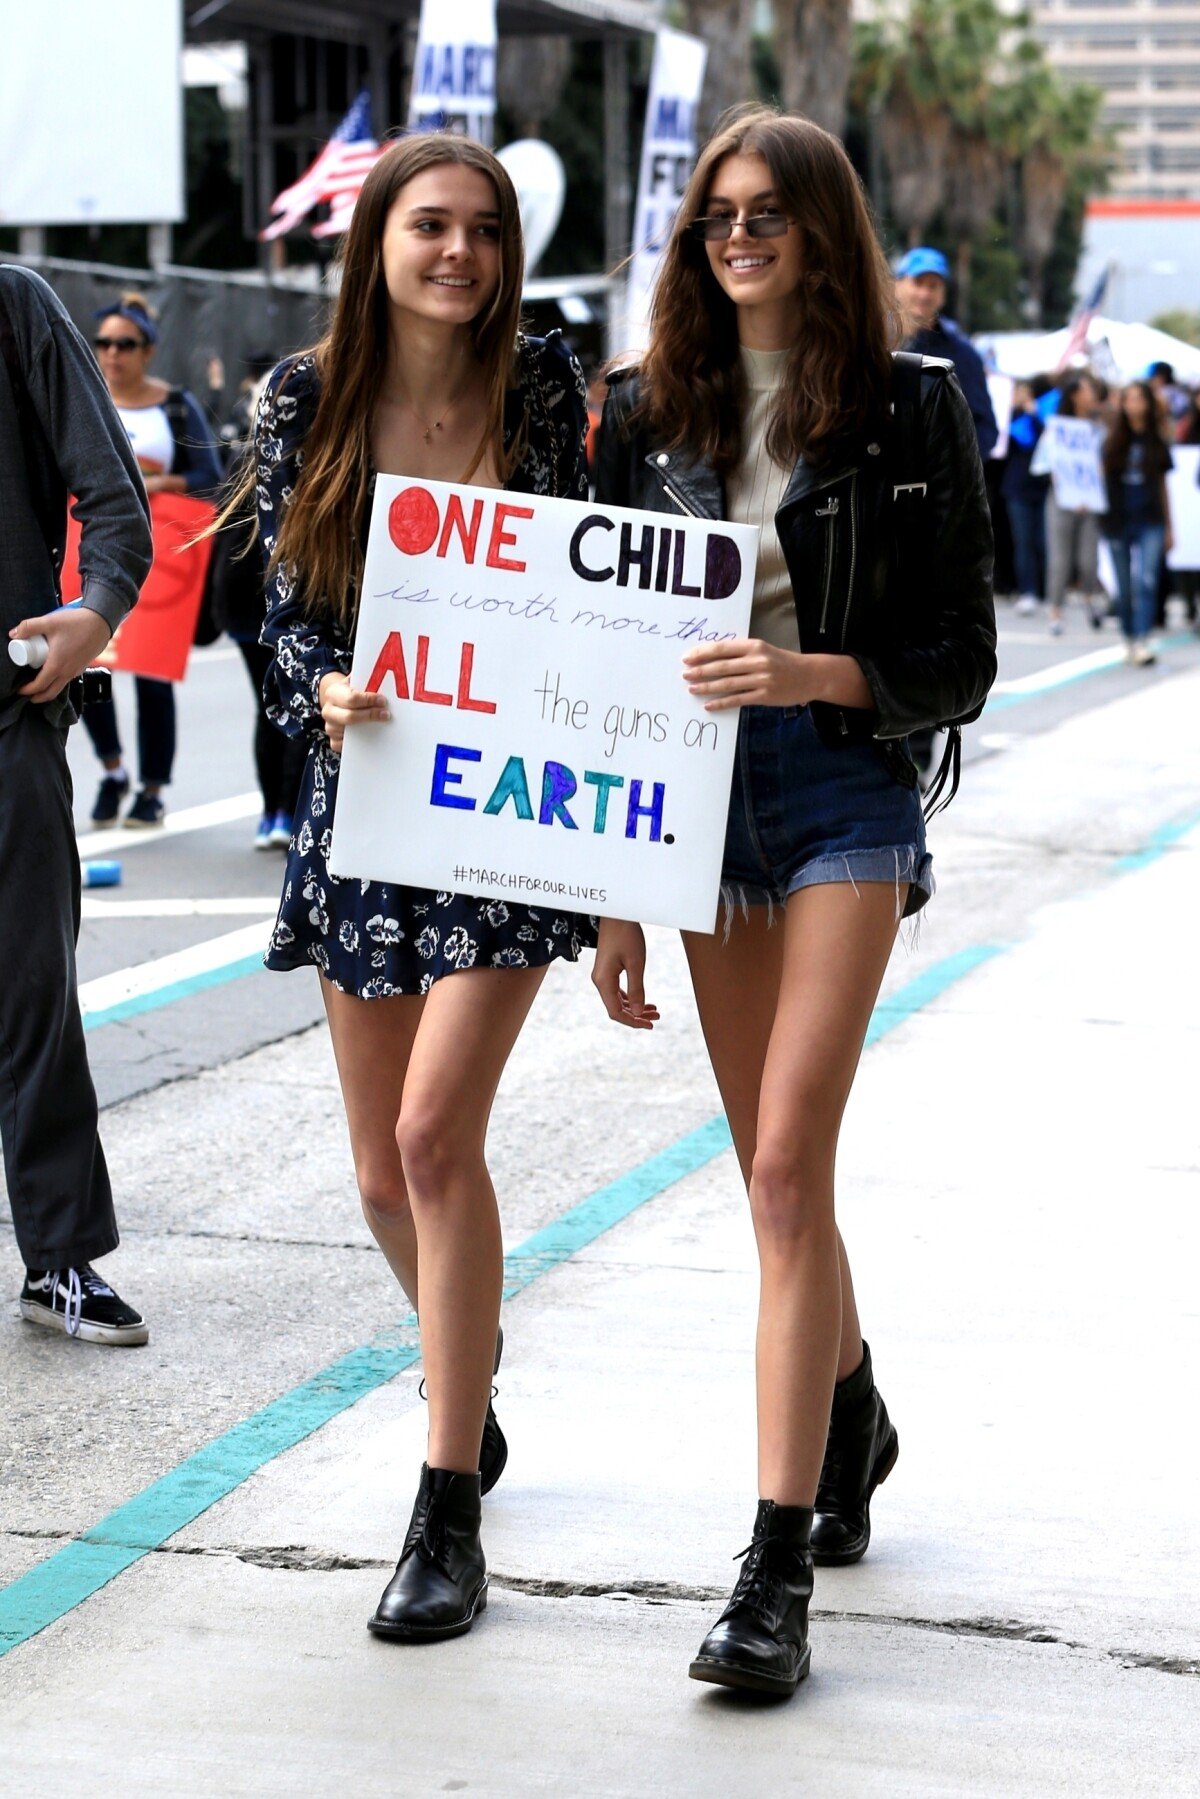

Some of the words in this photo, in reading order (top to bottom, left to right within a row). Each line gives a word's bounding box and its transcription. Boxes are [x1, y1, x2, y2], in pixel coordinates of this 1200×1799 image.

[388, 486, 535, 573] ONE
[569, 514, 742, 600] CHILD
[373, 579, 439, 603] is
[450, 592, 559, 623] worth
[572, 610, 661, 635] more
[664, 616, 737, 641] than
[365, 631, 497, 715] ALL
[534, 669, 589, 730] the
[604, 704, 670, 758] guns
[683, 718, 718, 750] on
[429, 743, 676, 845] EARTH.
